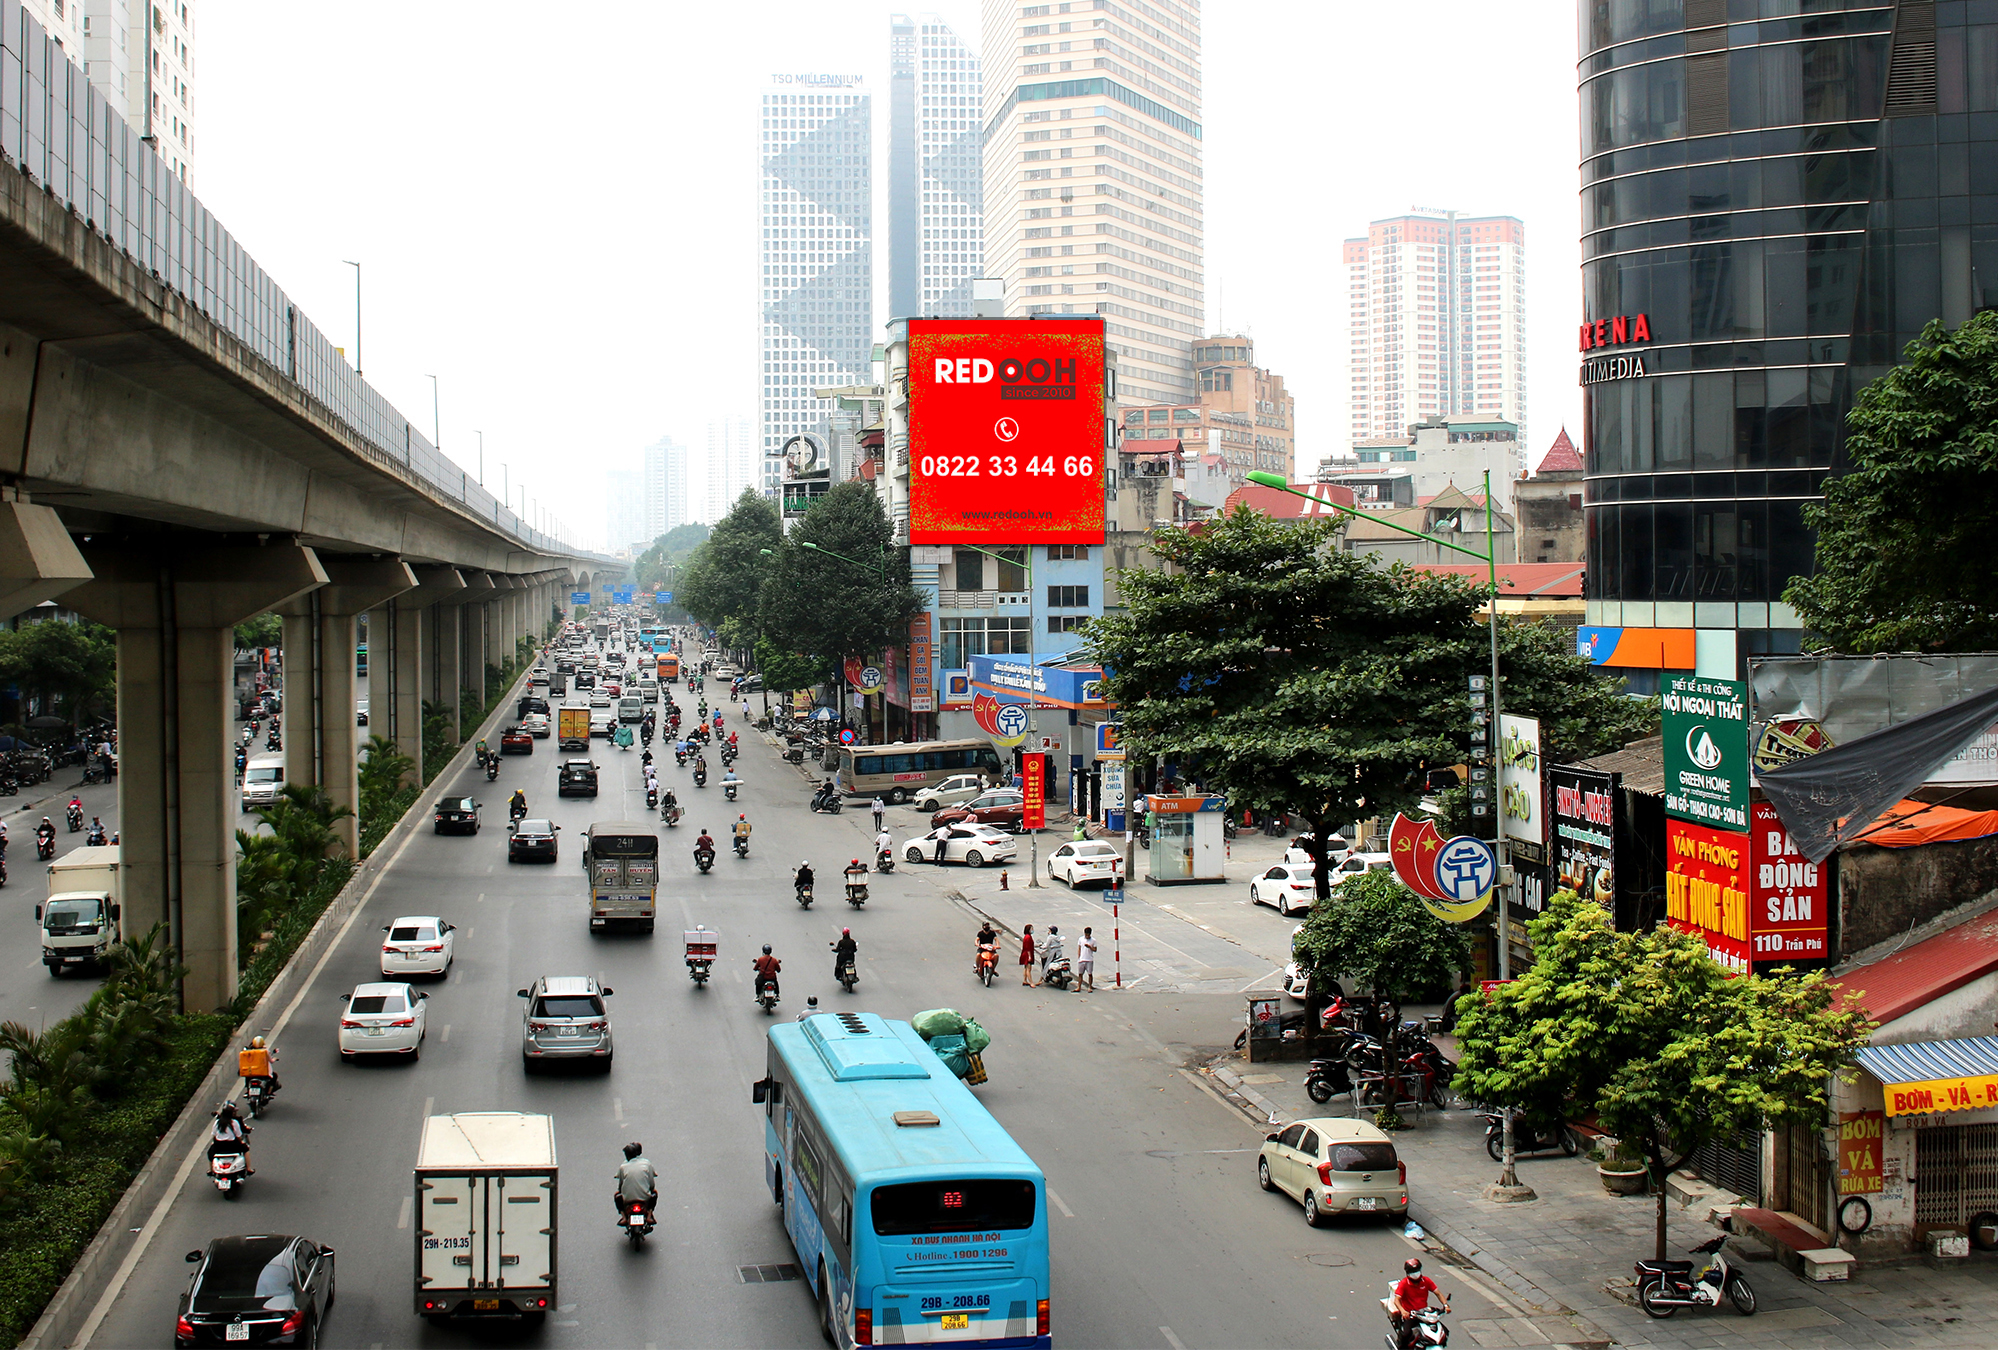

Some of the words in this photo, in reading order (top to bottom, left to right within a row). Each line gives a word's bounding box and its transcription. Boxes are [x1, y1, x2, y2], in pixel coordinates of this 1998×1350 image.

[796, 74, 863, 84] MILLENNIUM
[935, 358, 994, 383] RED
[998, 358, 1077, 384] OOH
[1005, 388, 1039, 398] since
[1043, 387, 1071, 398] 2010
[921, 456, 980, 476] 0822
[989, 456, 1017, 476] 33
[1026, 456, 1055, 476] 44
[1064, 456, 1093, 476] 66
[961, 509, 1053, 520] www.redooh.vn
[915, 687, 928, 695] ANH
[1713, 682, 1733, 697] CÔNG
[1662, 690, 1681, 716] NỘI
[1682, 696, 1716, 721] NGOẠI
[1716, 694, 1744, 721] THẤT
[1679, 770, 1705, 788] GREEN
[1705, 775, 1731, 794] HOME
[1161, 802, 1179, 810] ATM
[1673, 829, 1696, 859] VĂN
[1698, 835, 1739, 870] PHÒNG
[1758, 858, 1818, 894] ĐỘNG
[1666, 861, 1689, 922] BẤT
[1689, 869, 1721, 937] ĐỘNG
[1722, 875, 1746, 942] SẢN
[1767, 887, 1812, 923] SẢN
[1754, 934, 1783, 952] 110
[1785, 936, 1804, 951] Trần
[1806, 937, 1822, 950] Phú
[1894, 1088, 1934, 1111] BƠM
[1947, 1082, 1971, 1106] VÁ
[1985, 1083, 1998, 1102] R
[1841, 1116, 1881, 1140] BƠM
[1847, 1144, 1875, 1171] VÁ
[1841, 1174, 1865, 1193] RỬA
[1867, 1175, 1882, 1191] XE
[943, 1192, 963, 1208] 02
[925, 1235, 940, 1244] BUS
[941, 1233, 970, 1244] NHANH
[972, 1232, 984, 1242] HÀ
[985, 1231, 1001, 1243] NỘI
[953, 1249, 979, 1259] 1900
[982, 1248, 1008, 1258] 1296
[921, 1297, 942, 1308] 29B
[953, 1294, 990, 1307] 208.66
